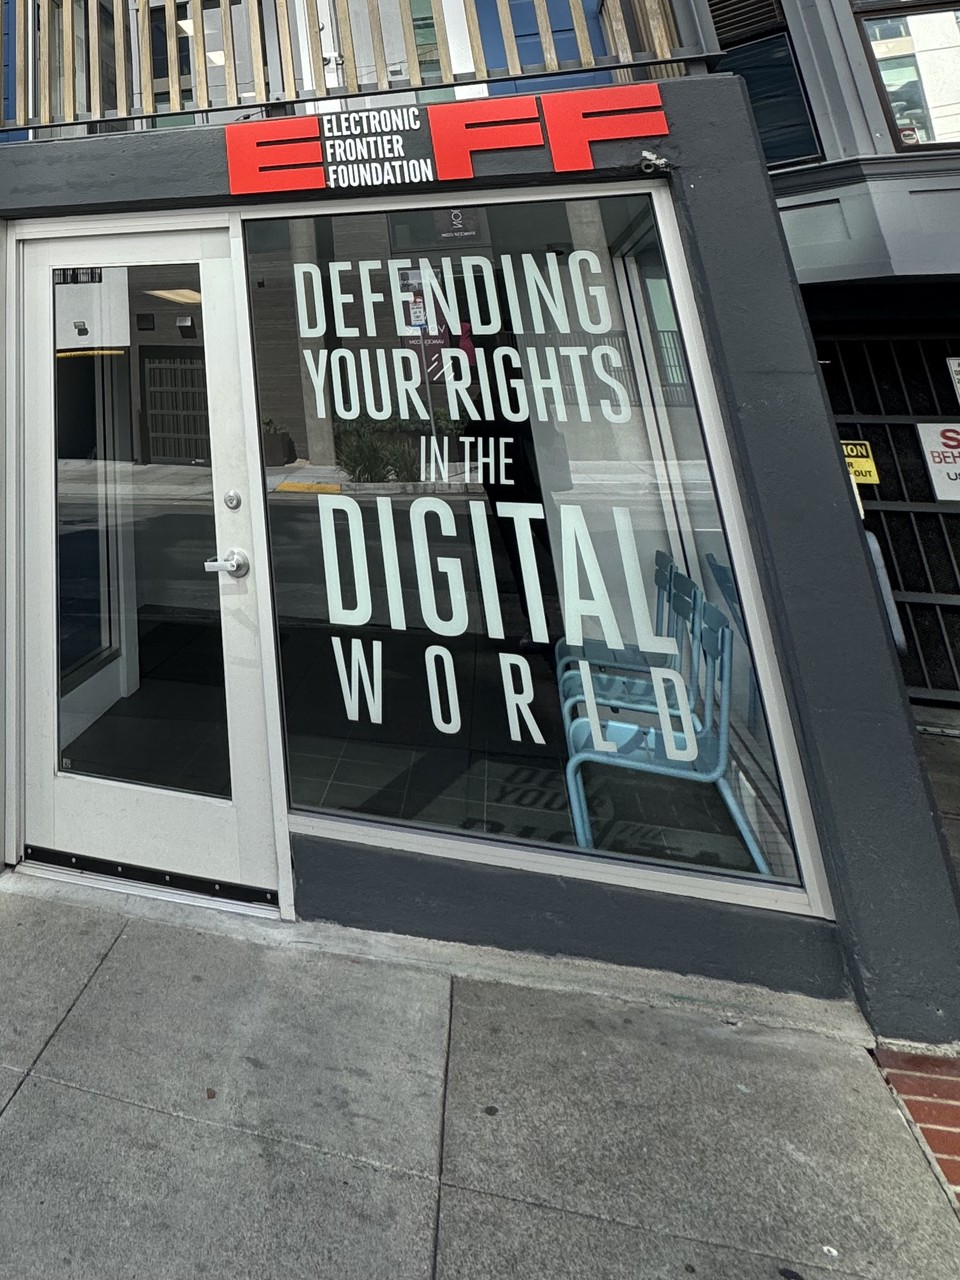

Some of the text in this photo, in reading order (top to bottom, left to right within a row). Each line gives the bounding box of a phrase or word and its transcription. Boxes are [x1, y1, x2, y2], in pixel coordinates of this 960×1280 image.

[323, 107, 421, 139] ELECTRONIC
[326, 135, 405, 164] FRONTIER
[328, 158, 434, 189] FOUNDATION
[293, 250, 613, 338] DEFENDING
[303, 346, 632, 423] YOUR RIGHTS
[419, 436, 515, 485] IN THE
[318, 494, 679, 654] DIGITAL
[331, 636, 698, 762] WORLD
